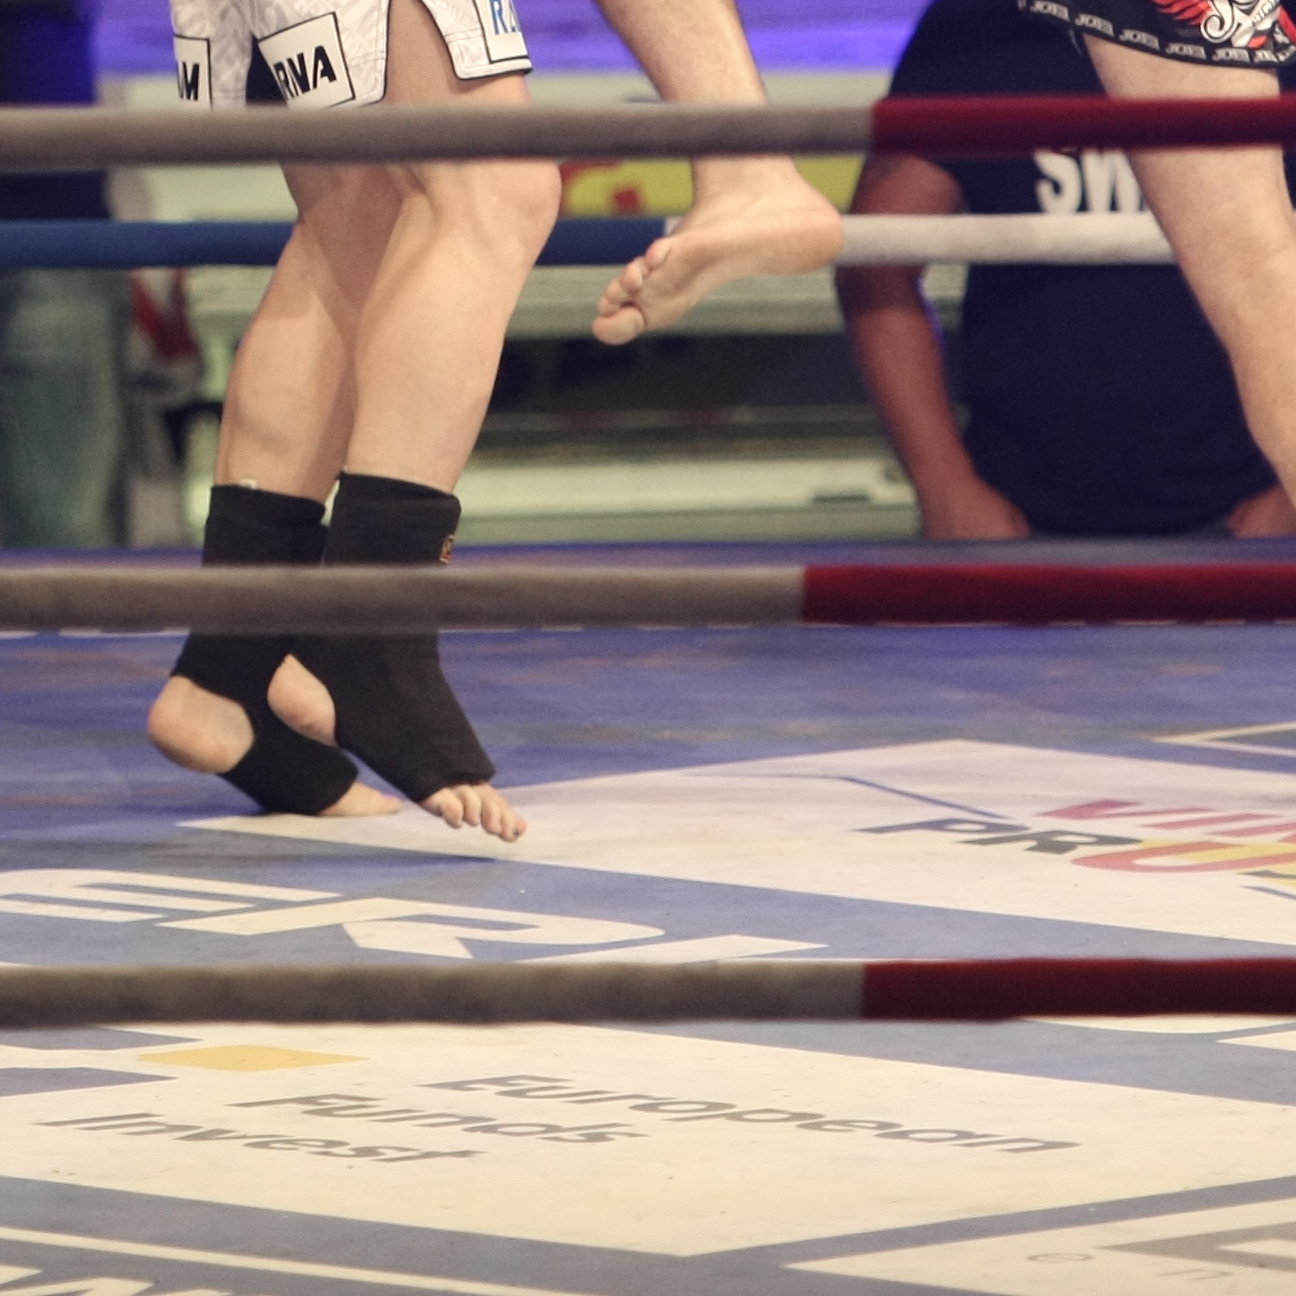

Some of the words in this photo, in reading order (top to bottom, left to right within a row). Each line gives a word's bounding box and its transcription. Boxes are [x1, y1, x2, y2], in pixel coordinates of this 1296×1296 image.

[36, 1112, 488, 1164] Invest
[224, 1093, 649, 1144] Funds
[416, 1074, 1084, 1154] European
